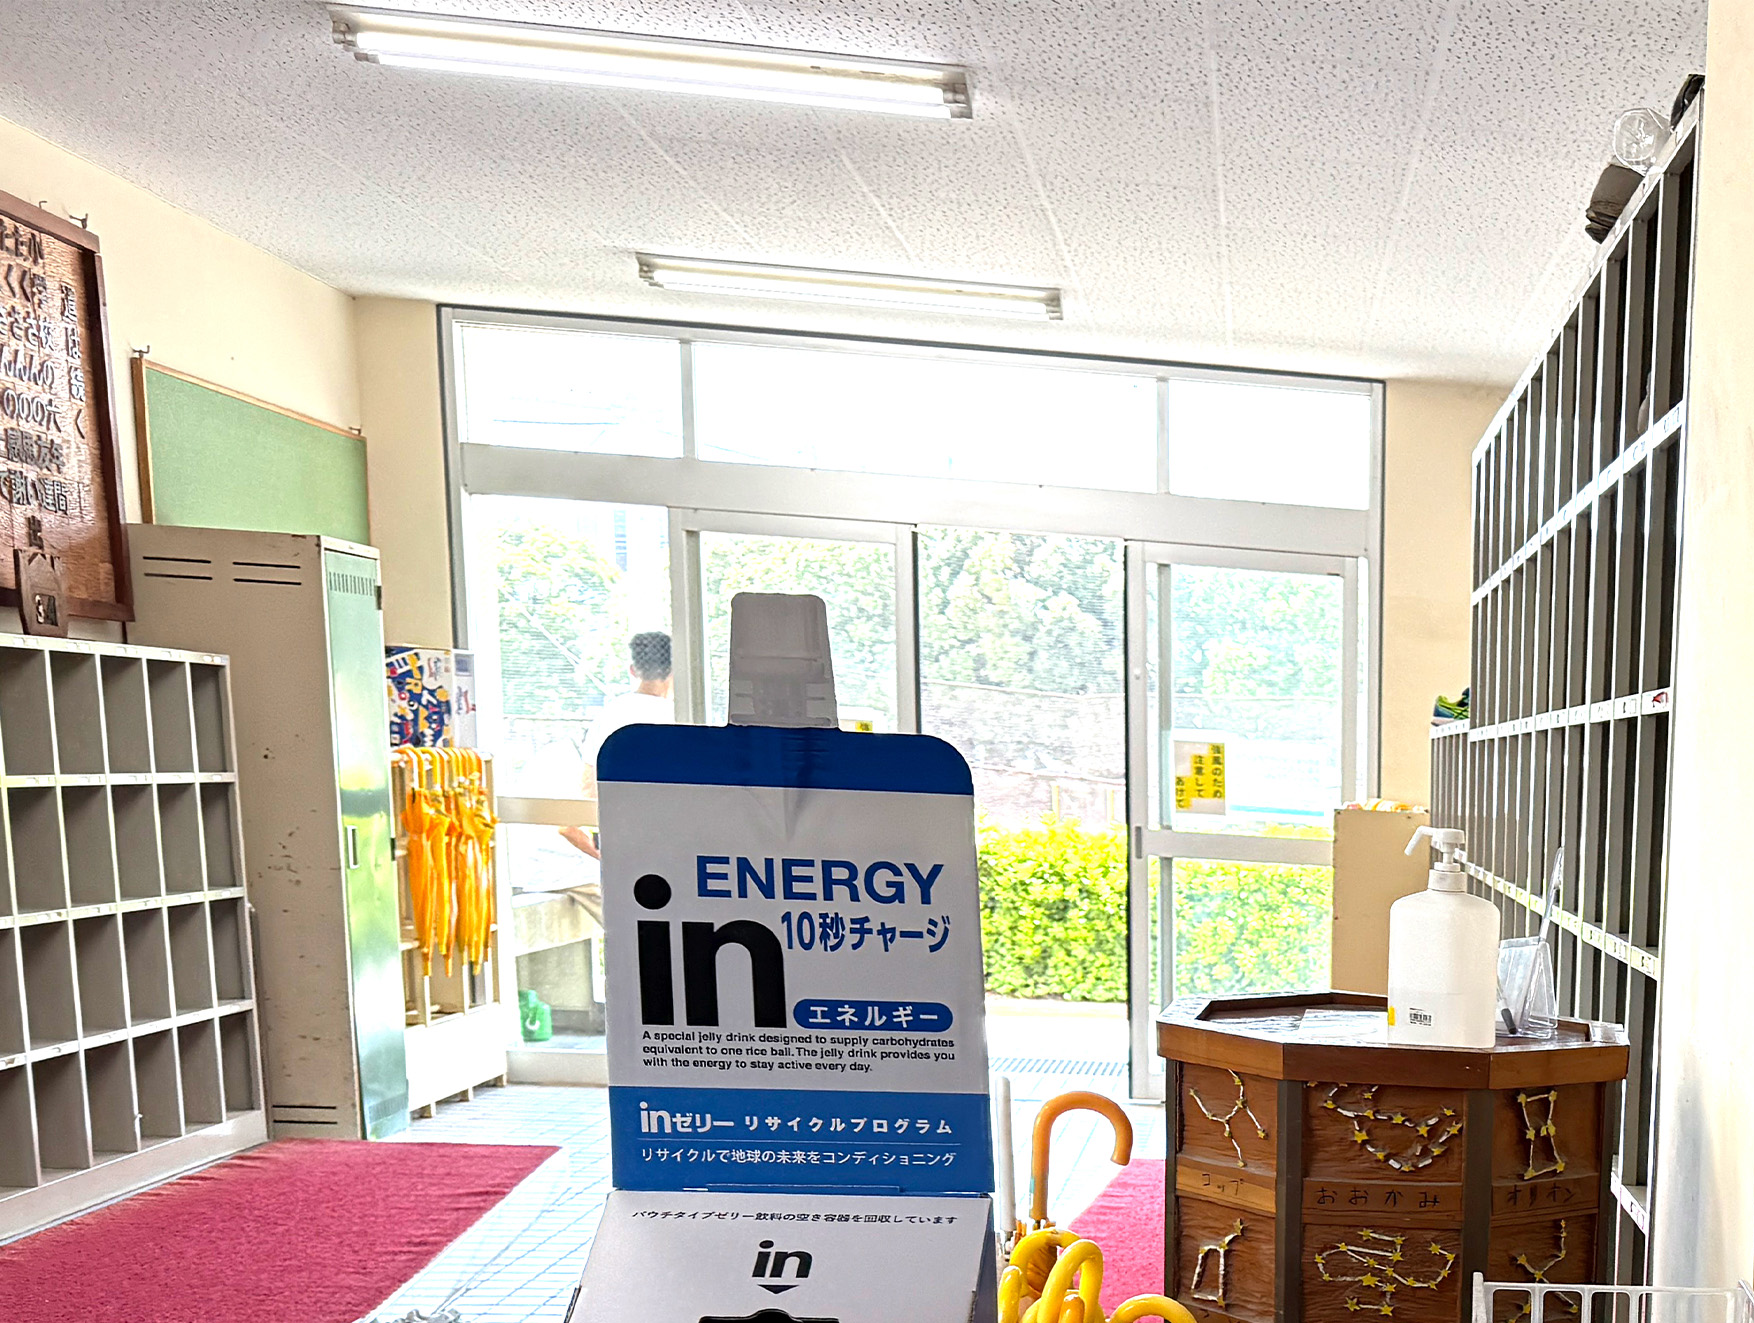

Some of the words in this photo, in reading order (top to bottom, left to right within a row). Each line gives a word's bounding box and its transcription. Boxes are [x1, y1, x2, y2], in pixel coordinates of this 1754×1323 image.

[695, 855, 945, 906] ENERGY
[633, 873, 788, 1029] in
[780, 910, 951, 954] 10秒チャージ
[808, 1005, 939, 1028] エネルギー
[643, 1031, 652, 1040] A
[654, 1032, 695, 1044] special
[698, 1032, 722, 1045] jelly
[725, 1033, 756, 1043] drink
[758, 1034, 812, 1047] designed
[815, 1036, 827, 1045] to
[830, 1036, 869, 1049] supply
[872, 1036, 955, 1049] carbohydrates
[642, 1044, 704, 1057] equivalent
[706, 1046, 718, 1056] to
[720, 1048, 743, 1056] one
[745, 1046, 768, 1057] rice
[770, 1047, 795, 1058] ball.
[796, 1047, 818, 1058] The
[820, 1047, 845, 1060] jelly
[847, 1048, 878, 1059] drink
[880, 1049, 932, 1062] provides
[933, 1053, 956, 1063] you
[643, 1056, 668, 1067] with
[670, 1058, 691, 1068] the
[692, 1060, 733, 1072] energy
[735, 1060, 748, 1070] to
[749, 1060, 776, 1073] stay
[778, 1060, 813, 1071] active
[815, 1063, 847, 1074] every
[849, 1062, 873, 1074] day.
[744, 1113, 953, 1136] リサイクルプログラム
[642, 1147, 957, 1168] リサイクルで地球の未来をコンディショニング
[1200, 1172, 1246, 1196] コップ
[1505, 1183, 1576, 1207] オリオン
[1316, 1186, 1441, 1208] おおかみ
[632, 1209, 958, 1226] パウチタイプゼリー飲料の空き容器を回収しています
[751, 1239, 814, 1280] in
